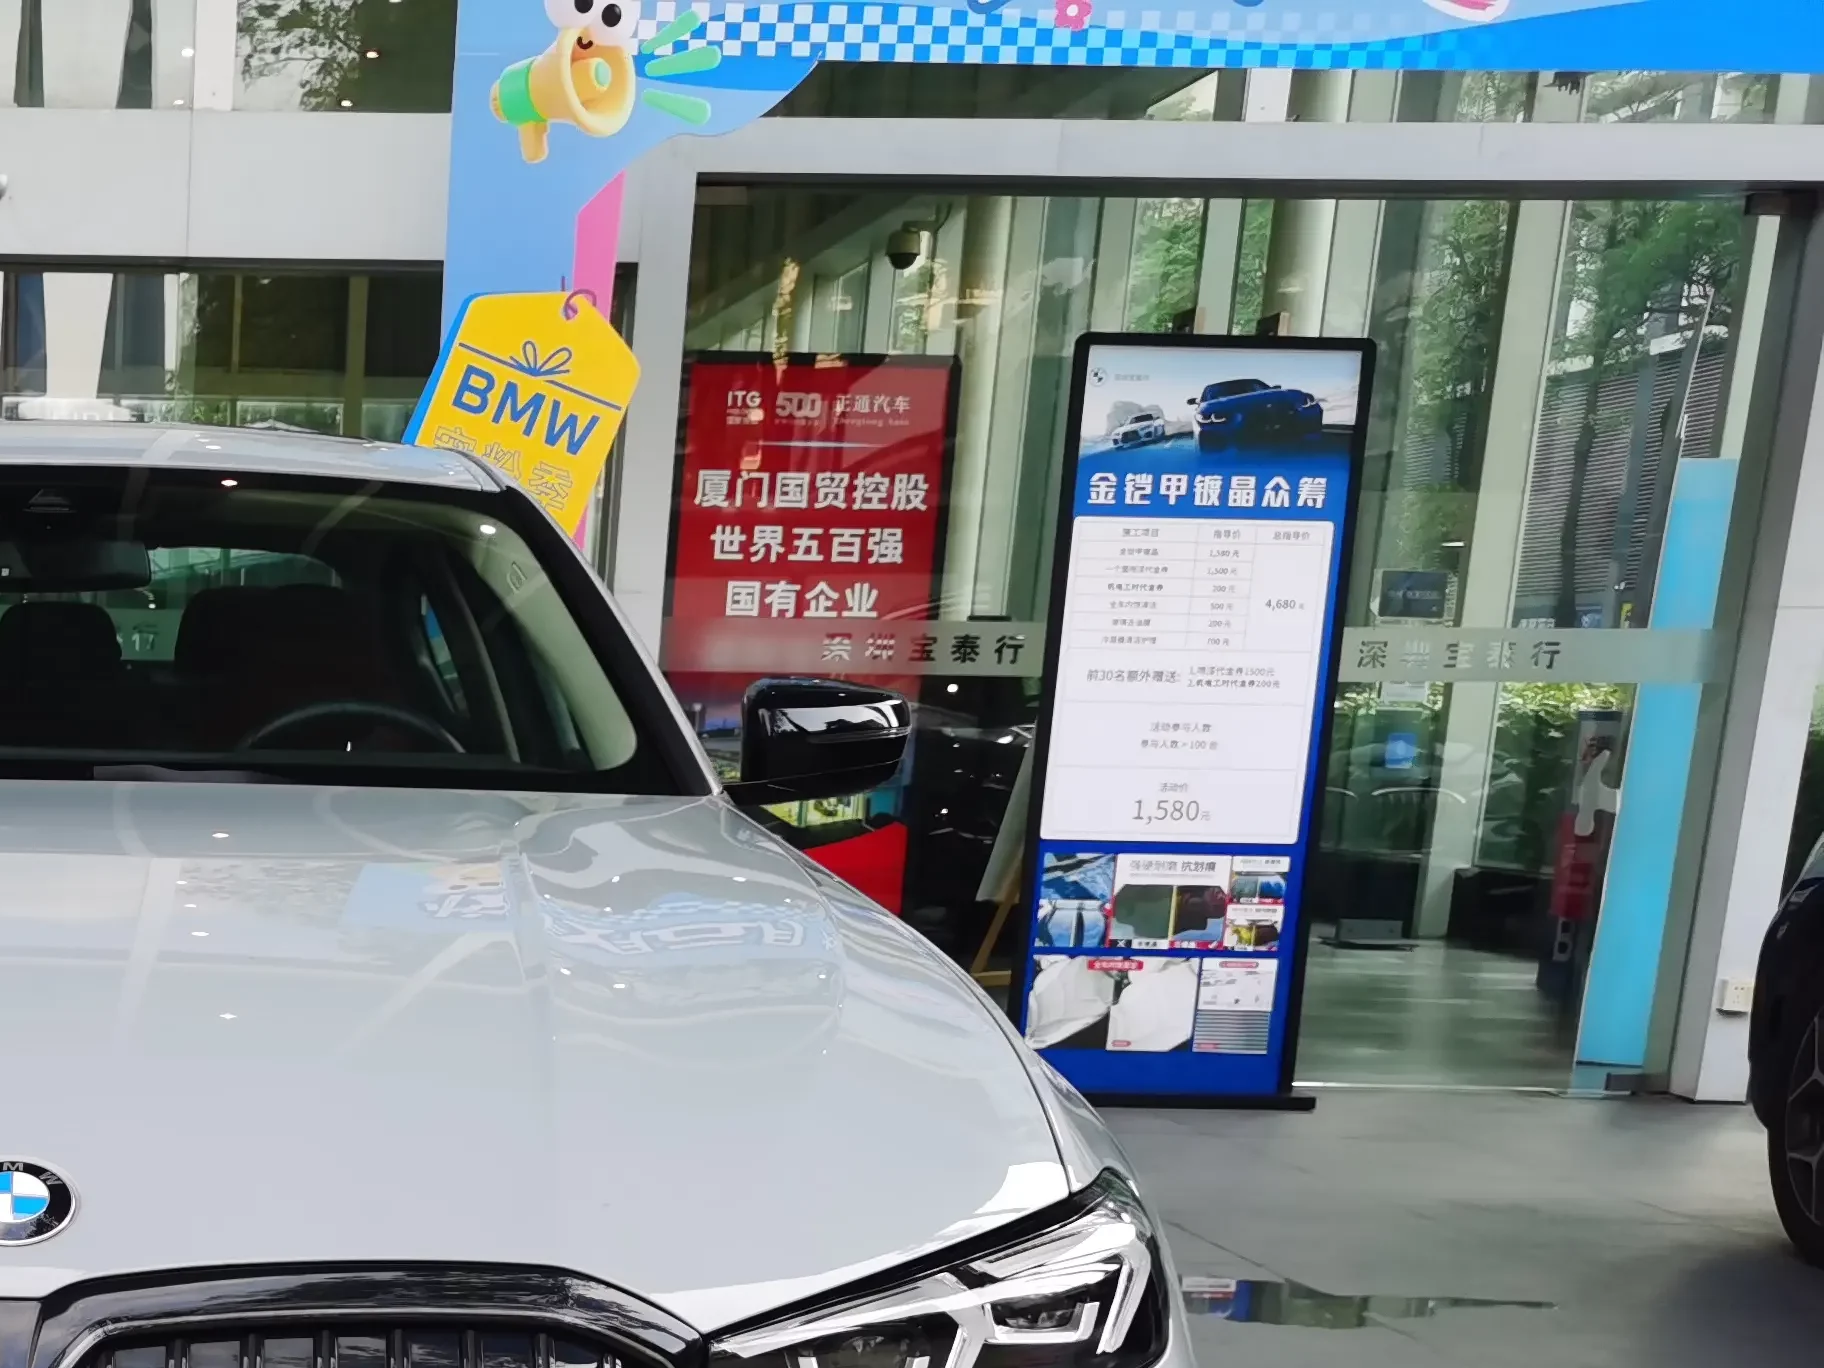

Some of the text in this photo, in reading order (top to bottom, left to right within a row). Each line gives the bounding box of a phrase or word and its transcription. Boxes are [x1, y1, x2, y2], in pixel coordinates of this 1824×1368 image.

[452, 364, 600, 456] BMW
[727, 390, 762, 407] ITG
[835, 395, 911, 414] 正通汽车
[693, 469, 929, 511] 厦门国贸控股
[1087, 472, 1327, 508] 金铠甲镀晶众筹
[710, 525, 904, 565] 世界五百强
[726, 580, 878, 618] 国有企业
[1265, 599, 1297, 611] 4,680
[1132, 799, 1200, 825] 1,580
